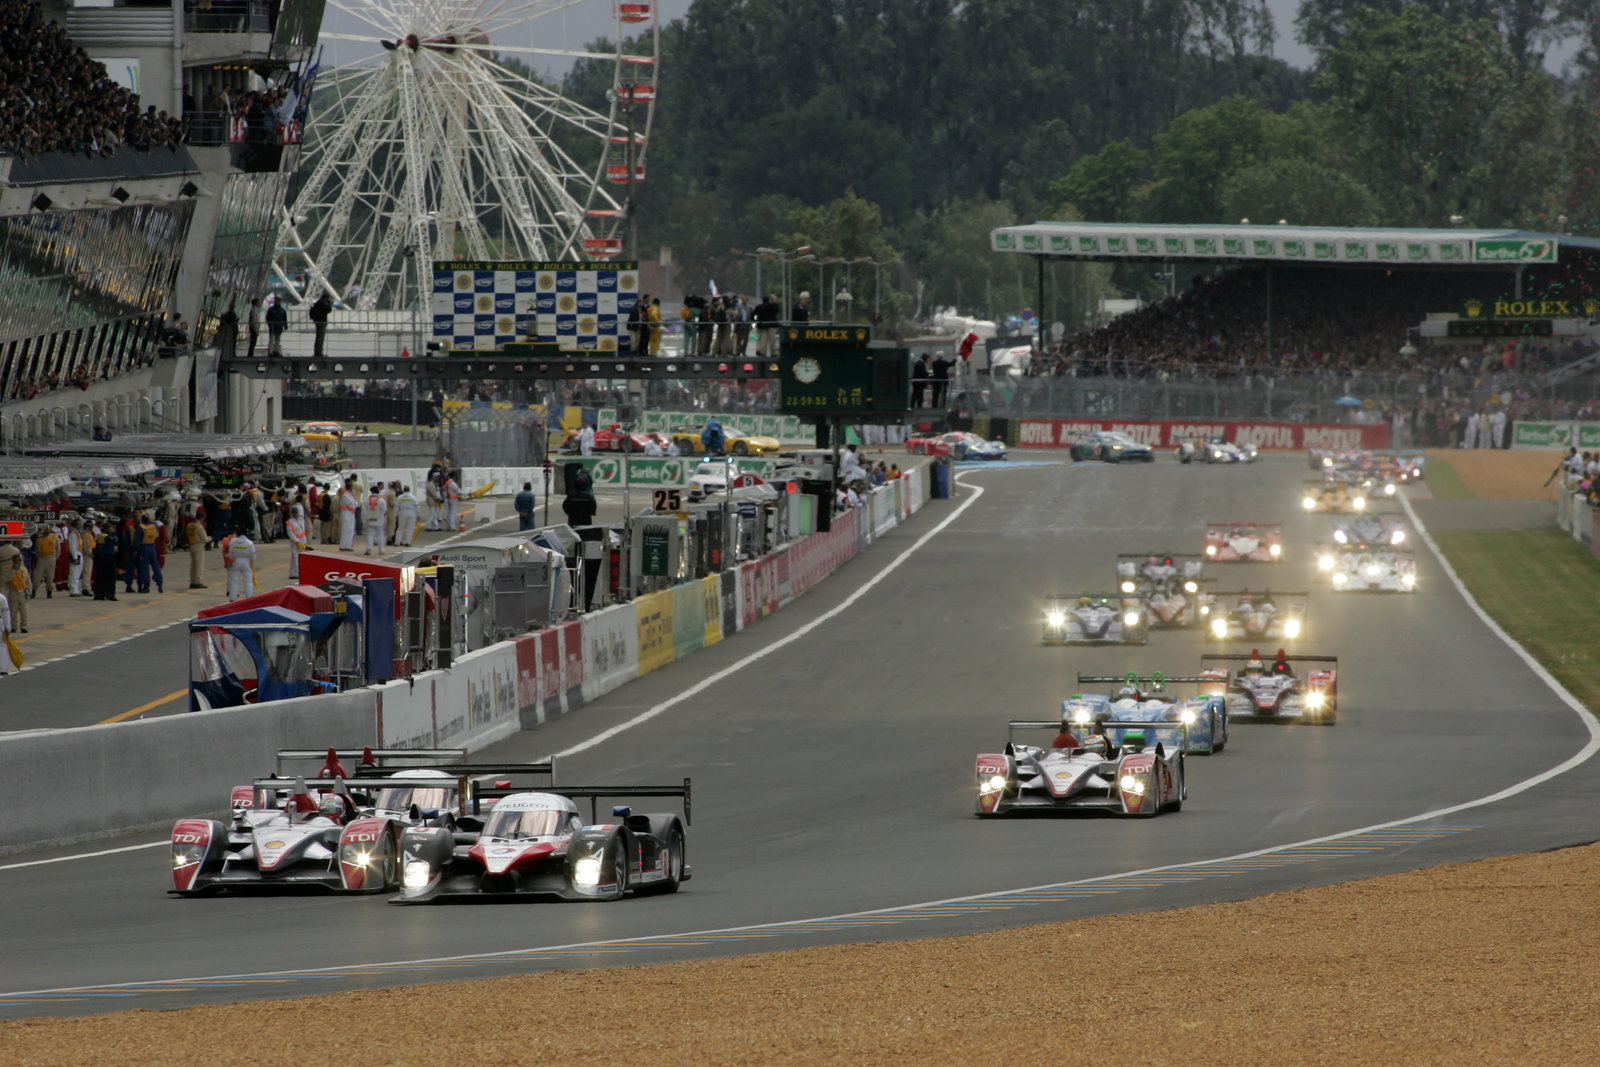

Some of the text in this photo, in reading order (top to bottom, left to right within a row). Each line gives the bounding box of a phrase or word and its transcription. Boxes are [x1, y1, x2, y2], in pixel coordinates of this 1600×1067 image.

[1494, 301, 1570, 315] ROLEX
[805, 330, 848, 339] ROLEX
[1020, 423, 1054, 443] MOTUL
[1235, 425, 1294, 448] MOTUL
[1302, 427, 1362, 449] MOTUL
[630, 466, 660, 479] Sarthe
[654, 489, 681, 511] 25
[440, 554, 486, 563] Audi Sport
[977, 765, 1001, 774] TDI
[1125, 765, 1150, 774] TDI
[233, 799, 254, 808] TD
[173, 833, 201, 844] TDI
[347, 833, 376, 843] TDI
